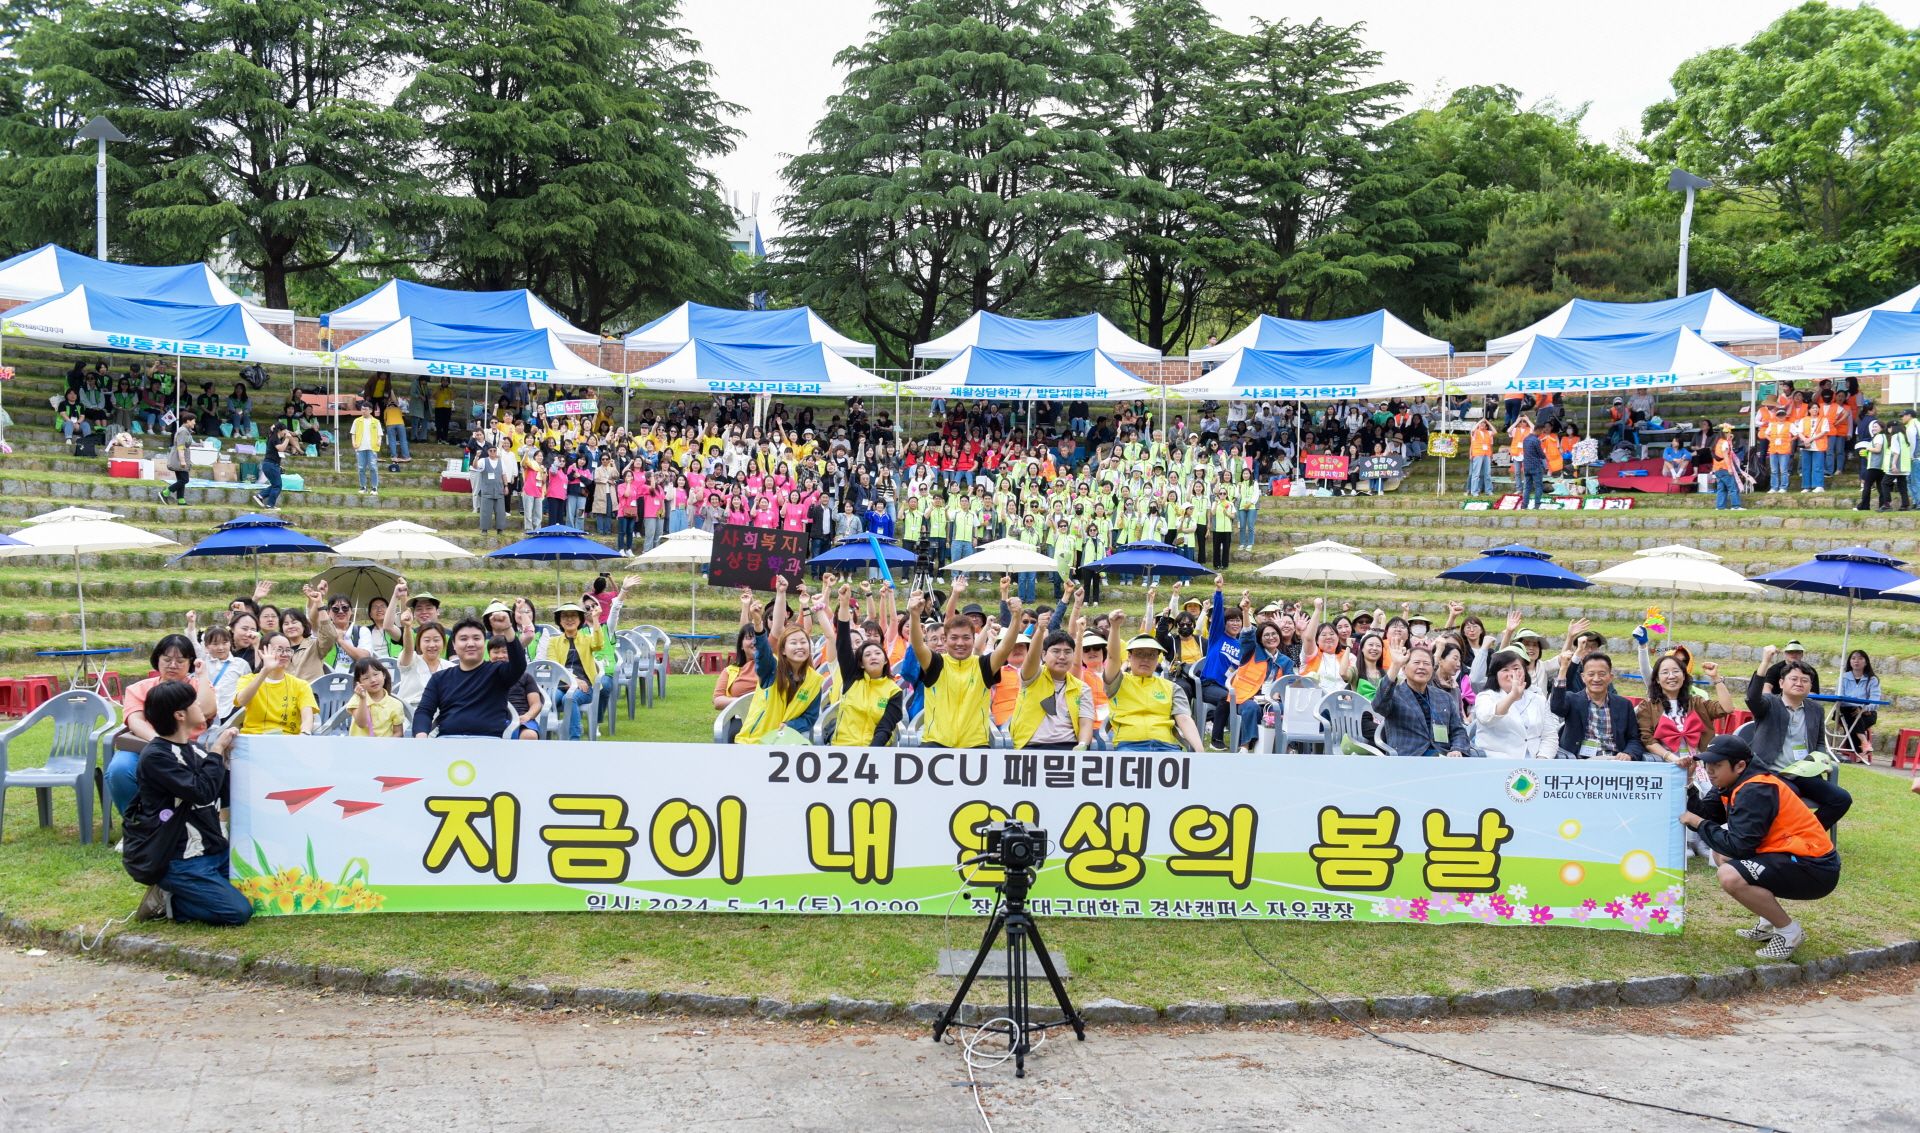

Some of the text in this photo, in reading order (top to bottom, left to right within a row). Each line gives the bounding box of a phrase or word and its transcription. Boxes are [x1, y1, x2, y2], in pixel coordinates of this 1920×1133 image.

[106, 334, 249, 359] 행동치료학과
[426, 362, 549, 382] 상담심리학과
[1841, 358, 1920, 374] 특수교
[708, 381, 822, 394] 임상심리학과
[1504, 373, 1679, 391] 사회복지상담학과
[950, 386, 1022, 398] 재활상담학과
[1036, 388, 1109, 399] 발달재활학과
[1240, 387, 1359, 398] 사회복지학과
[768, 751, 1192, 791] 2024 DCU 패밀리데이
[1544, 775, 1663, 791] 대구사이버대학교
[1543, 791, 1663, 800] DAEGU CYBER UNIVERSITY
[423, 790, 747, 884] 지금이
[806, 797, 897, 885] 내
[1308, 805, 1513, 893] 봄날
[1031, 899, 1143, 916] 대구대학교
[1150, 900, 1261, 917] 경산캠퍼스
[1267, 901, 1355, 919] 자유광장
